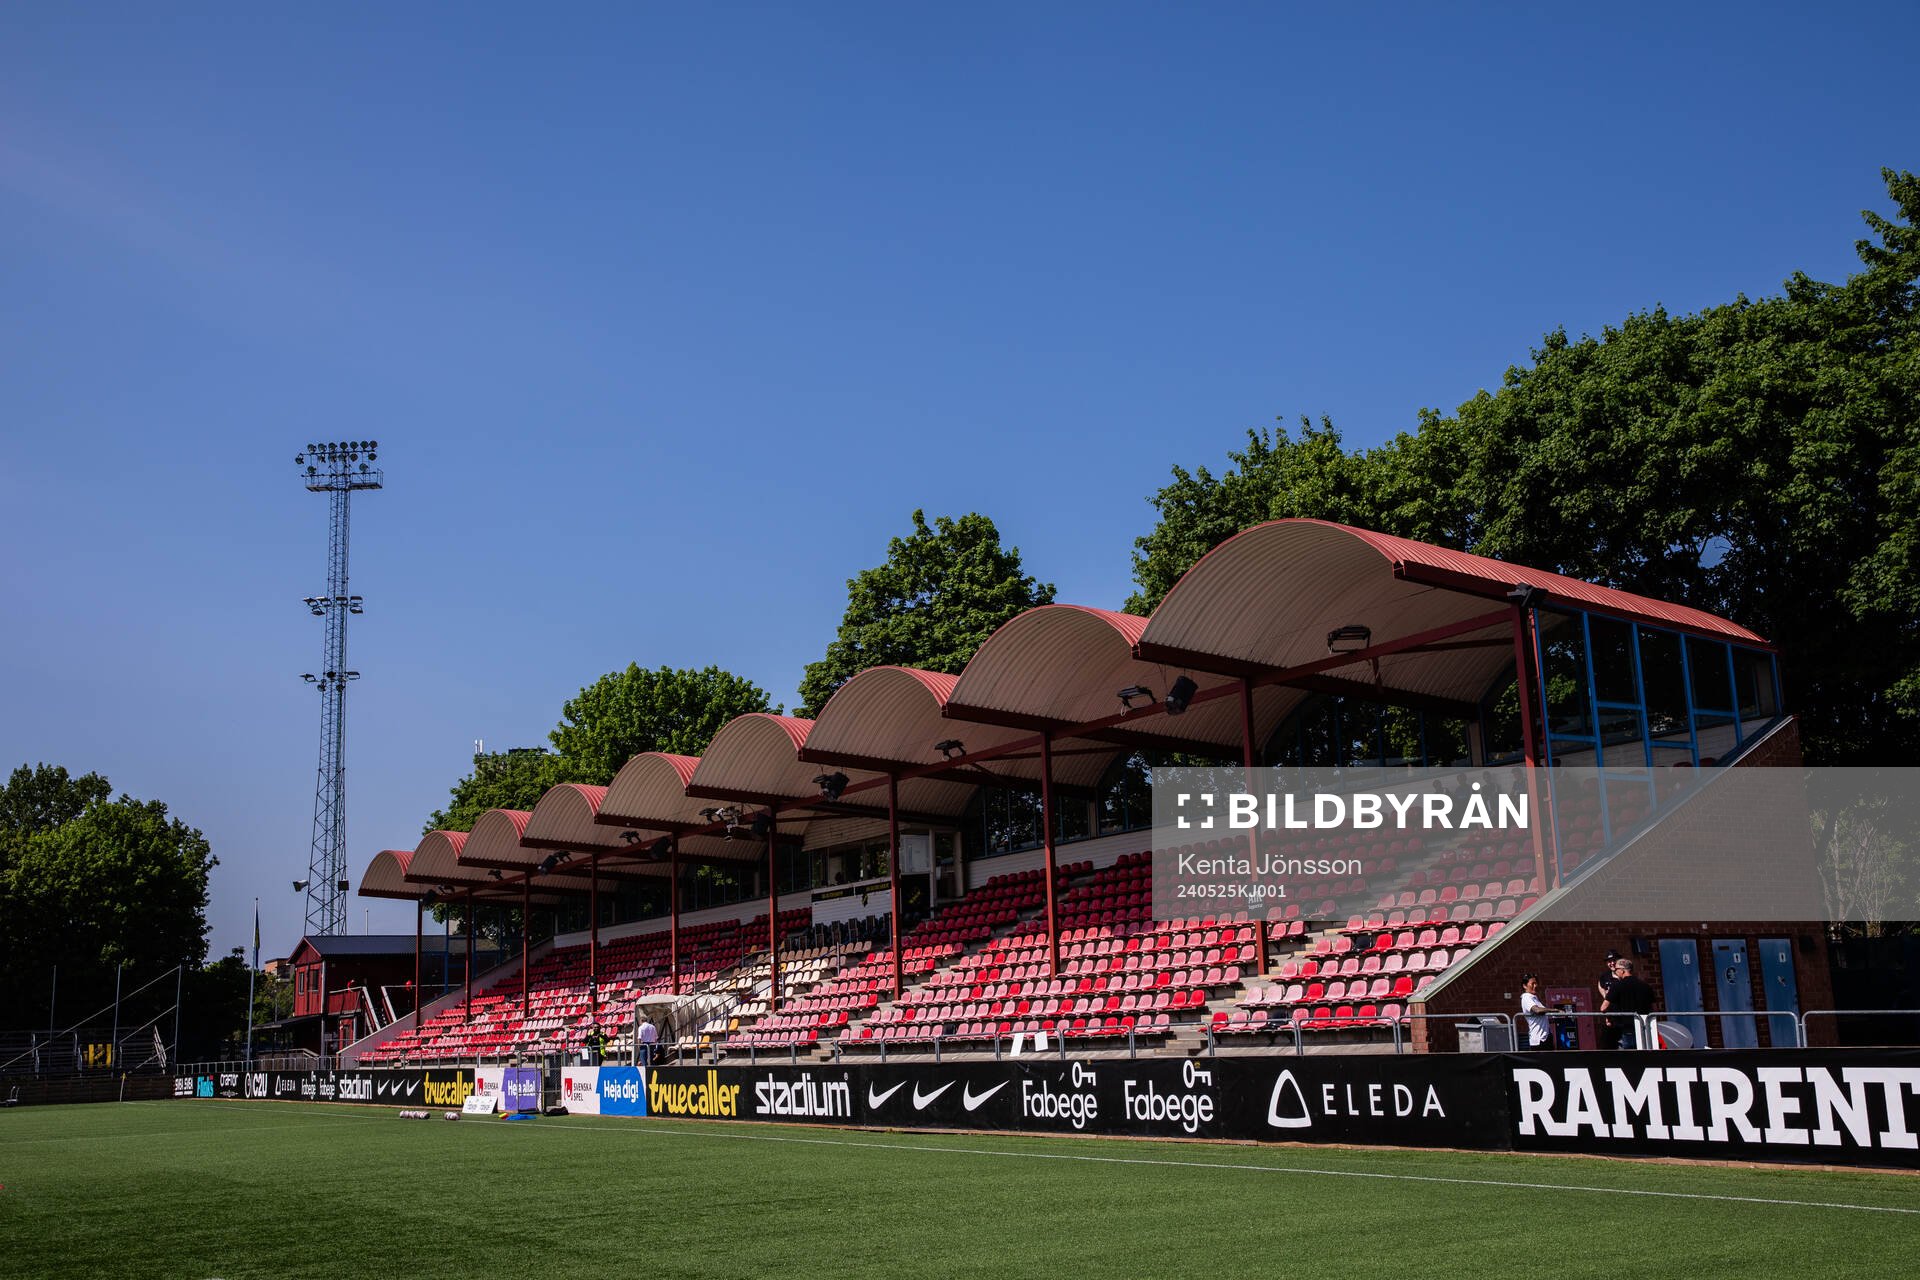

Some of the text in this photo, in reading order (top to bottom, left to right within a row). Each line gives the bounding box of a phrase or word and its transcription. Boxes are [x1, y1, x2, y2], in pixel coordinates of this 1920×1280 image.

[339, 1073, 372, 1100] stadium
[423, 1071, 474, 1105] truecaller
[573, 1082, 592, 1092] SVENSKA
[573, 1092, 584, 1102] SPEL
[603, 1079, 639, 1103] Heja dig!
[648, 1069, 740, 1117] truecaller
[755, 1072, 851, 1117] stadium
[1022, 1079, 1098, 1129] Fabege
[1322, 1083, 1446, 1118] ELEDA
[1124, 1079, 1214, 1133] Fabege
[1512, 1067, 1920, 1149] RAMIRENT
